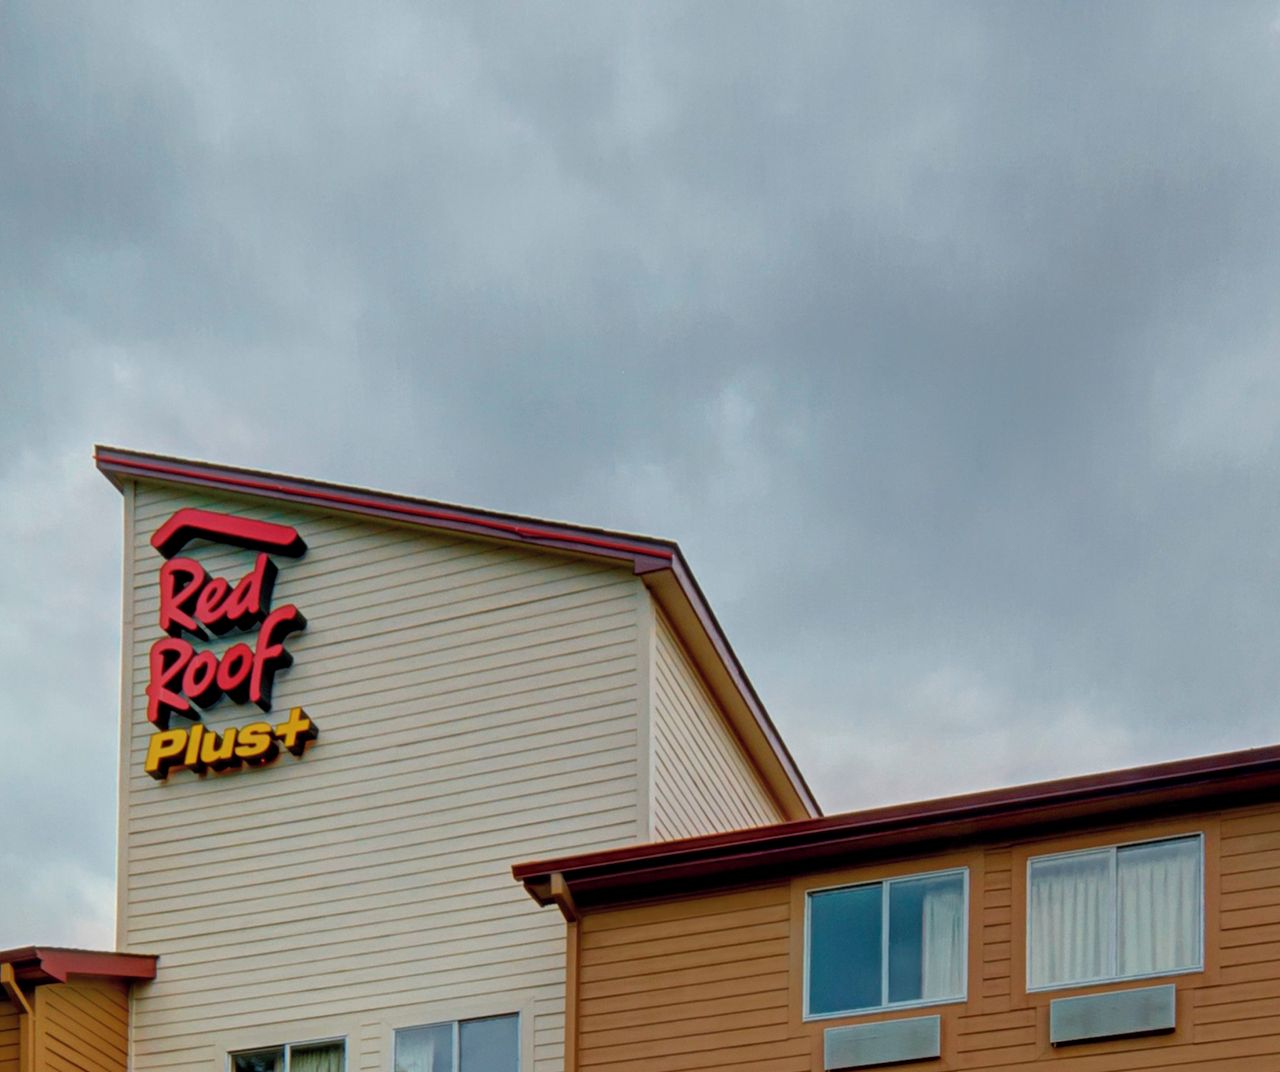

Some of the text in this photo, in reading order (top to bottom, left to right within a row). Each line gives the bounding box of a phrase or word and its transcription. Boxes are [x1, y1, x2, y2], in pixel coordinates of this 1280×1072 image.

[160, 553, 271, 633] Red
[146, 604, 300, 724] Roof
[144, 706, 313, 775] Plus+
